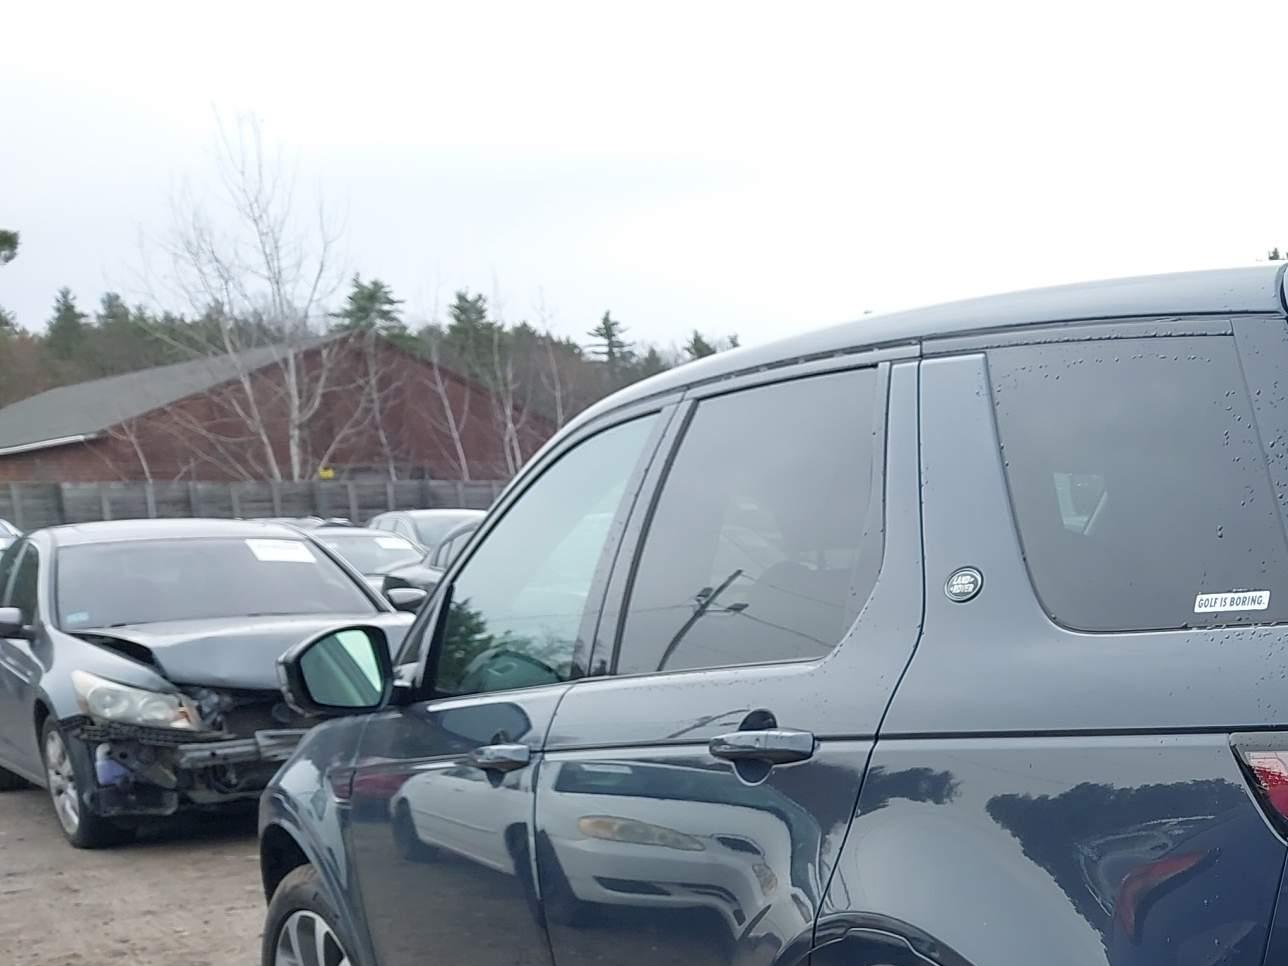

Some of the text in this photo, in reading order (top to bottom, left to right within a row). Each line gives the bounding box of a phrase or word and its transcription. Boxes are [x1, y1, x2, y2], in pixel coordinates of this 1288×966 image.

[1198, 595, 1265, 609] GOLF IS BORING.
